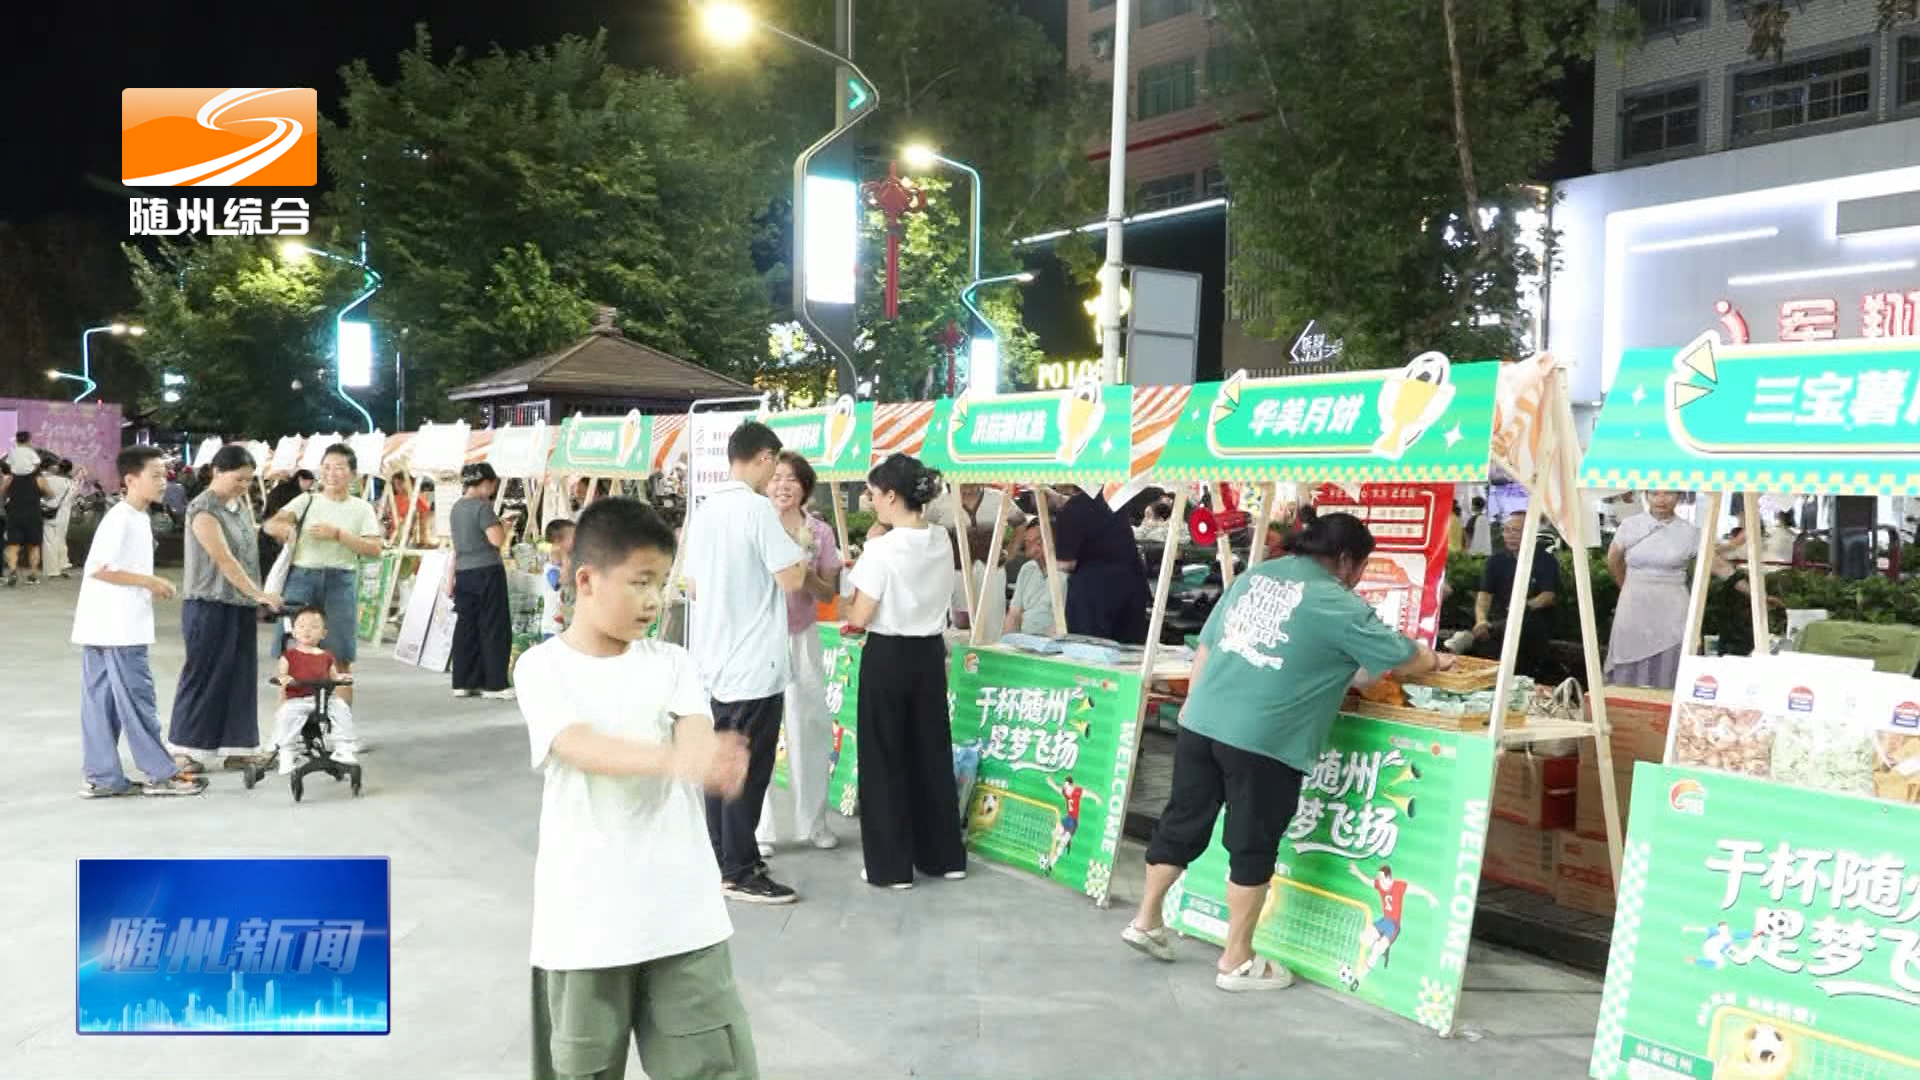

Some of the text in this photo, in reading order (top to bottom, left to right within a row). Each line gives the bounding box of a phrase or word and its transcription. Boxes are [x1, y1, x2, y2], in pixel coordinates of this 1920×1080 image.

[1248, 394, 1365, 437] 华美月饼
[1745, 369, 1920, 426] 三宝薯
[975, 687, 1071, 728] 干杯随州
[981, 725, 1079, 770] 足梦飞扬
[1101, 720, 1137, 857] WELCOME
[1440, 800, 1488, 976] WELCOME
